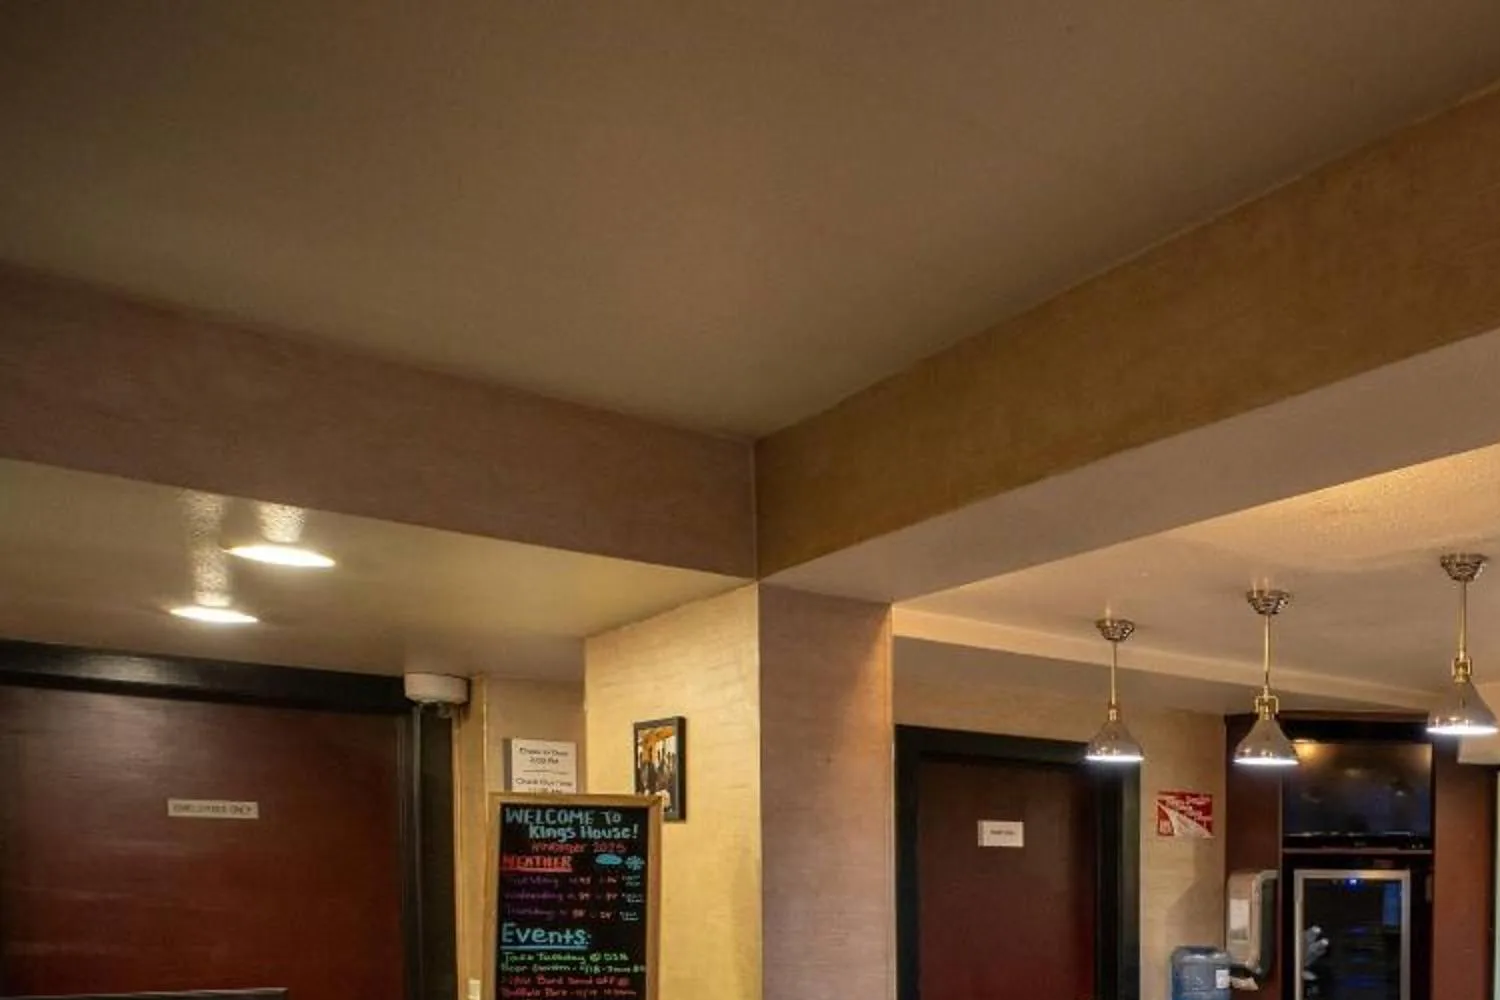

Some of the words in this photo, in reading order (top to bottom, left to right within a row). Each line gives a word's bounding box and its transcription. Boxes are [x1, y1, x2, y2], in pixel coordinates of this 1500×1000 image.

[505, 807, 594, 825] WELCOME
[529, 824, 577, 843] Kings
[580, 824, 639, 840] House!
[501, 923, 592, 945] Events:
